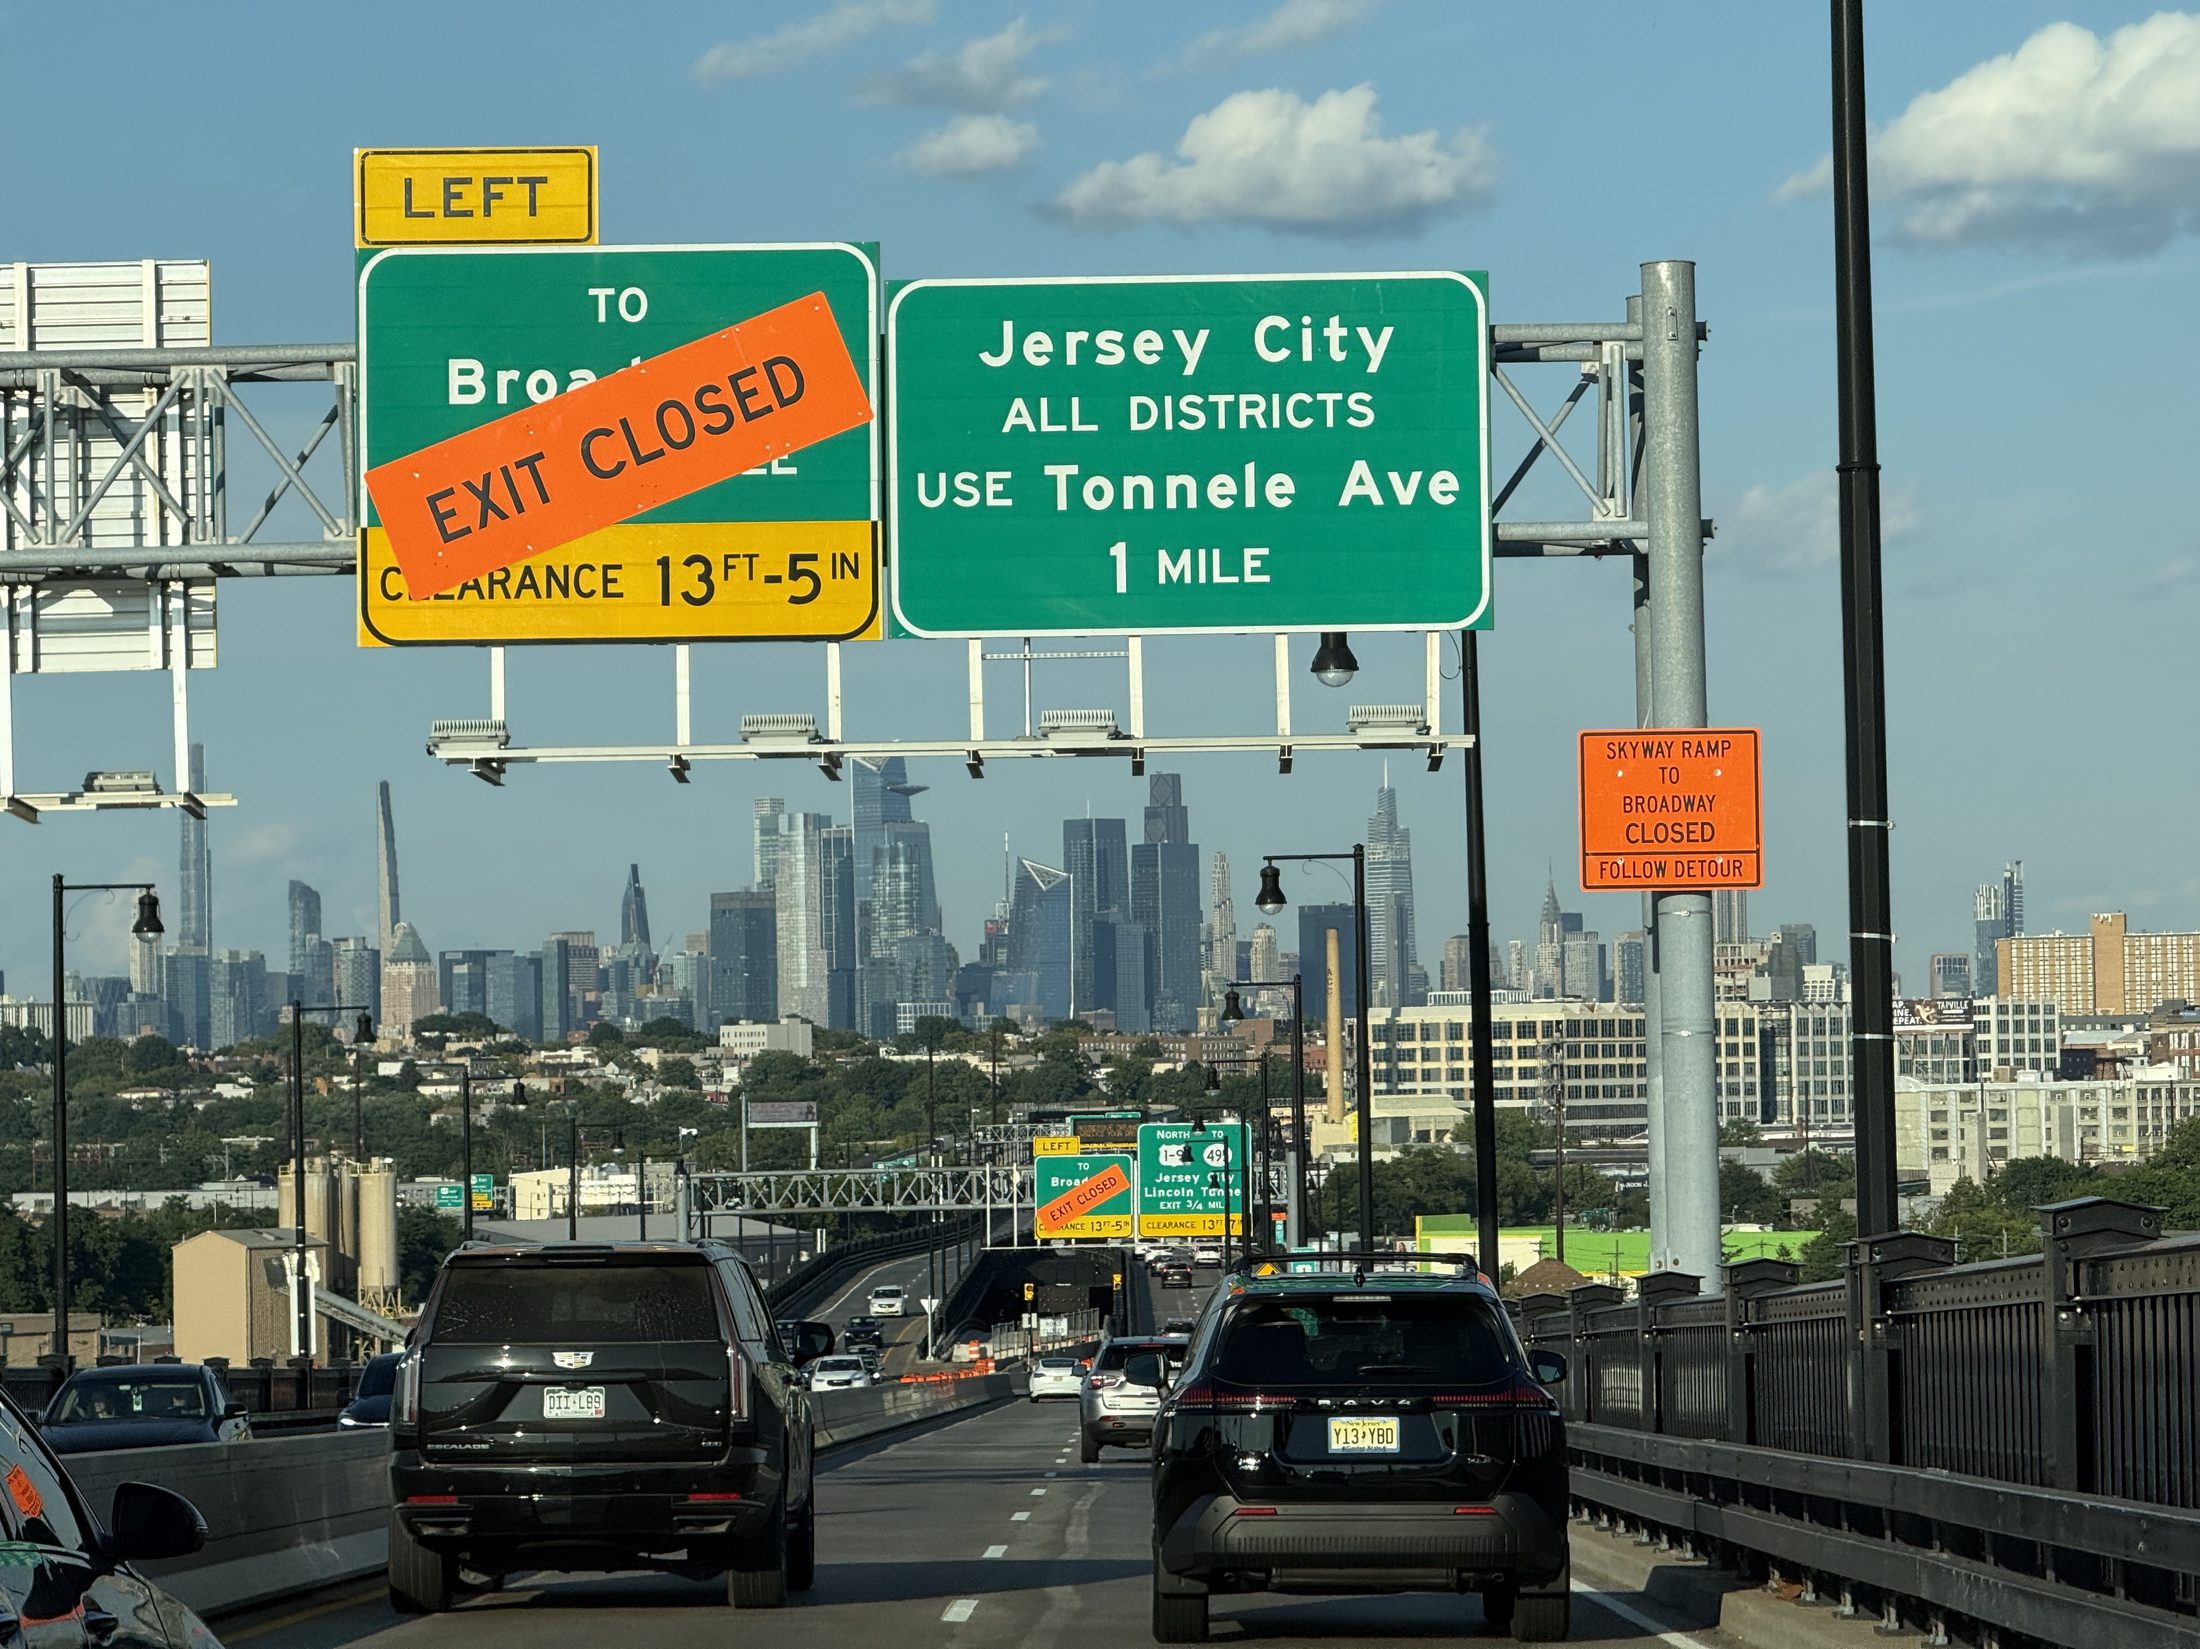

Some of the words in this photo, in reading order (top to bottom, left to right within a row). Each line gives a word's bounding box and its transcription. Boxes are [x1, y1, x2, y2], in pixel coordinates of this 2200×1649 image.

[404, 177, 548, 217] LEFT
[588, 287, 649, 322] TO
[978, 320, 1210, 376] Jersey
[1253, 315, 1395, 374] City
[1002, 396, 1099, 433] ALL
[1129, 391, 1376, 431] DISTRICTS
[425, 451, 552, 544] EXIT
[581, 355, 805, 479] CLOSED
[917, 471, 1013, 508] USE
[1044, 461, 1296, 511] Tonnele
[1338, 459, 1461, 507] Ave
[1109, 541, 1127, 593] 1
[1157, 547, 1271, 585] MILE
[380, 564, 624, 601] CARANCE
[1606, 741, 1674, 760] SKYWAY
[1682, 740, 1731, 758] RAMP
[1659, 766, 1680, 785] TO
[1623, 795, 1716, 814] BROADWAY
[1625, 822, 1715, 844] CLOSED
[1600, 861, 1667, 879] FOLLOW
[1675, 860, 1743, 878] DETOUR
[1937, 1001, 1969, 1010] TAPVILLE
[1893, 1016, 1922, 1025] EPEAT.
[1157, 1130, 1190, 1139] NORTH
[1043, 1142, 1071, 1151] LEFT
[1207, 1149, 1224, 1162] 49
[1077, 1163, 1090, 1171] TO
[1155, 1173, 1200, 1184] Jersey
[1050, 1201, 1073, 1221] EXIT
[1077, 1177, 1117, 1205] CLOSED
[1144, 1187, 1194, 1198] Lincoln
[1160, 1201, 1181, 1209] EXIT
[1186, 1200, 1203, 1210] 3/4
[1147, 1221, 1196, 1230] CLEARANCE
